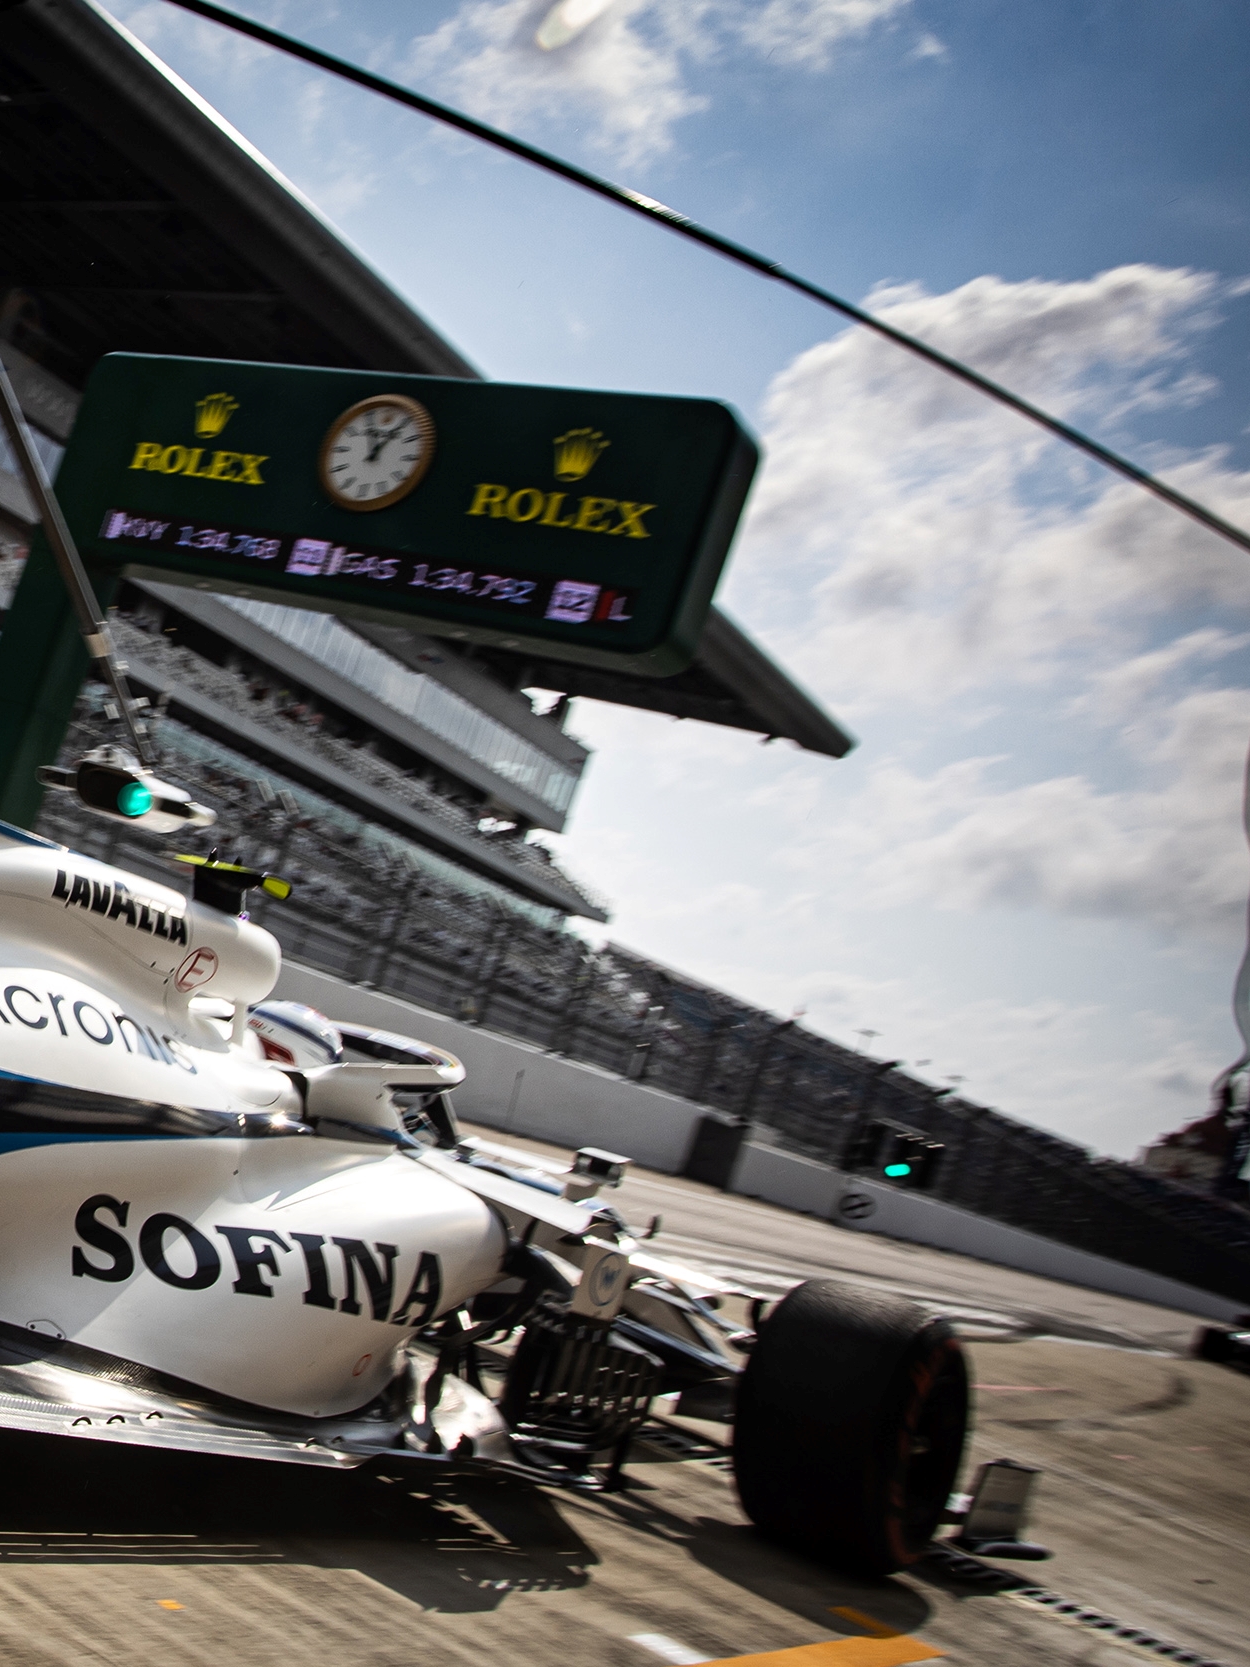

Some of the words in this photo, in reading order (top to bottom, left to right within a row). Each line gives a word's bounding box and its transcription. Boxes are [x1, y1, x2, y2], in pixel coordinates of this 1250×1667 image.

[128, 440, 270, 487] ROLEX
[465, 482, 658, 541] ROLEX
[70, 1192, 444, 1328] SOFINA
